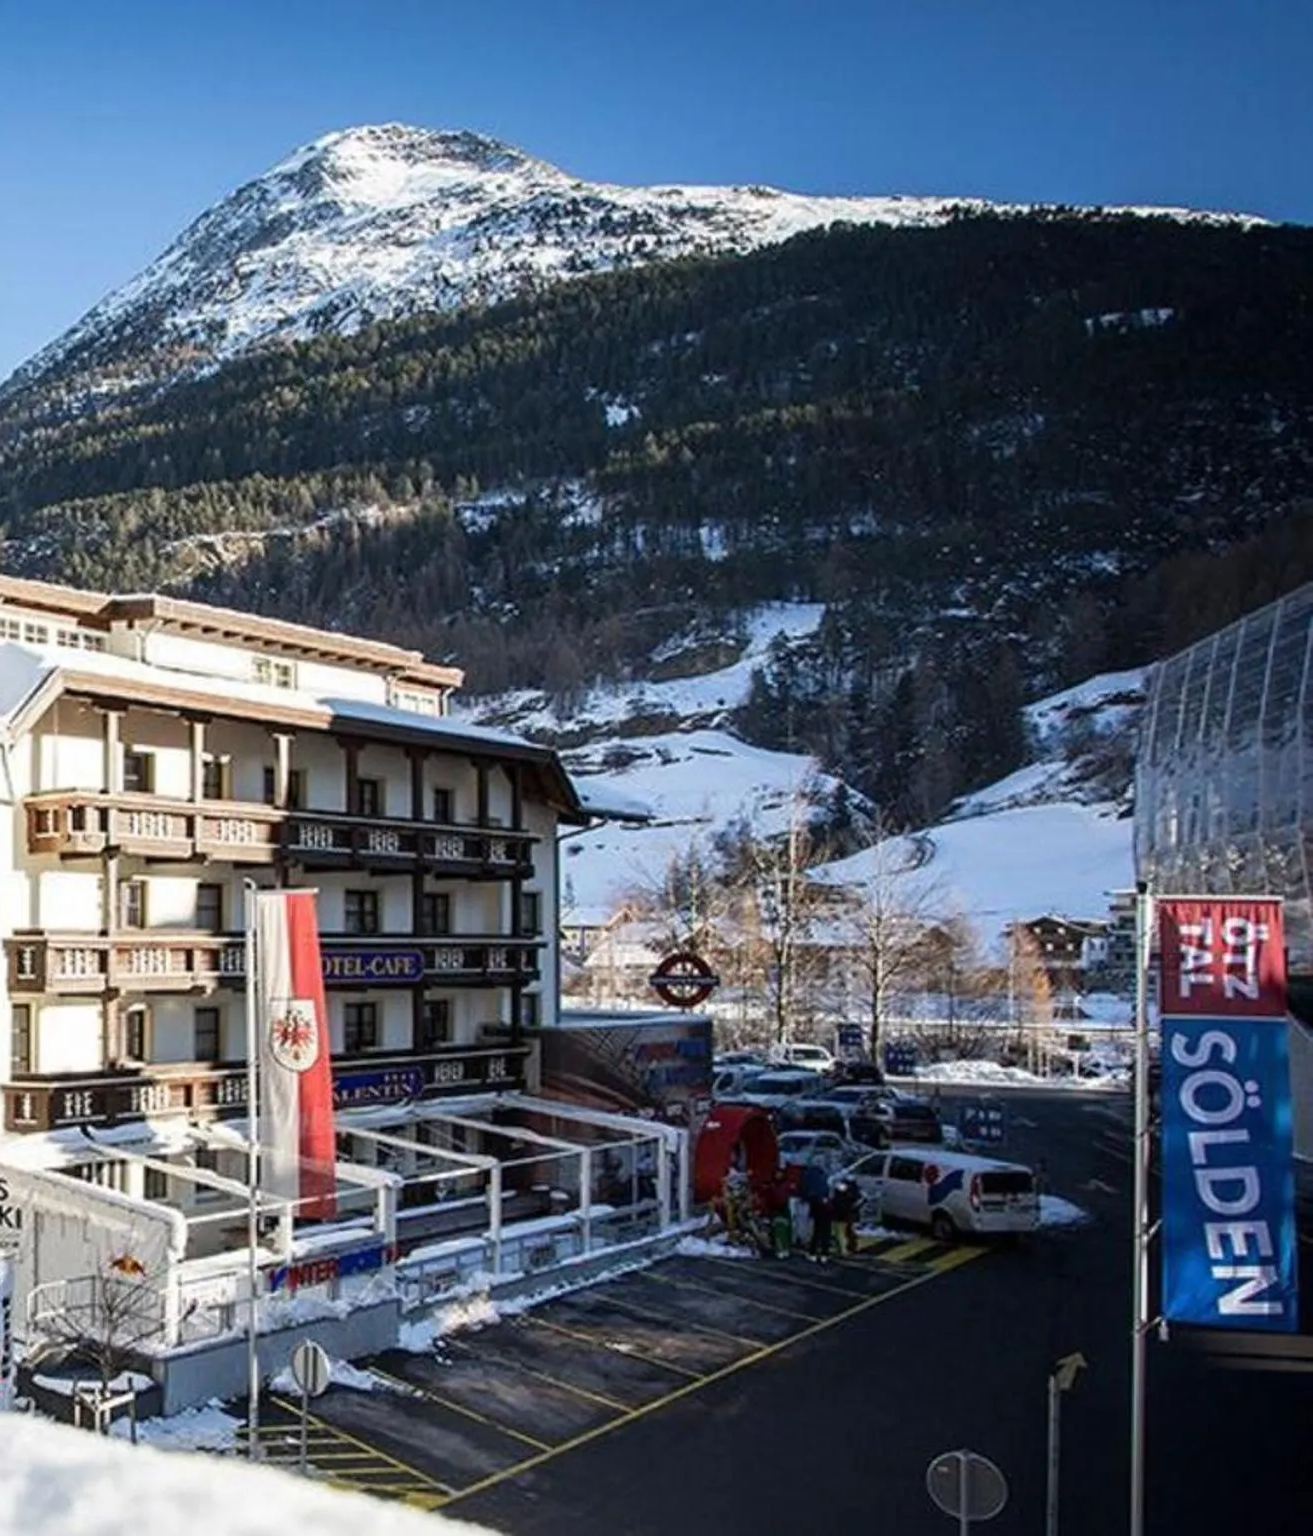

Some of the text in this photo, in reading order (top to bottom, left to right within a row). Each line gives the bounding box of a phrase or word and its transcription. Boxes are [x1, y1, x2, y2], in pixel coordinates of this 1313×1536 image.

[324, 955, 417, 977] OTEL-CAFE
[1178, 917, 1214, 998] TAL
[1222, 916, 1270, 1000] ÖTZ
[333, 1079, 413, 1103] ALENTIN
[1171, 1030, 1284, 1316] SÖLDEN
